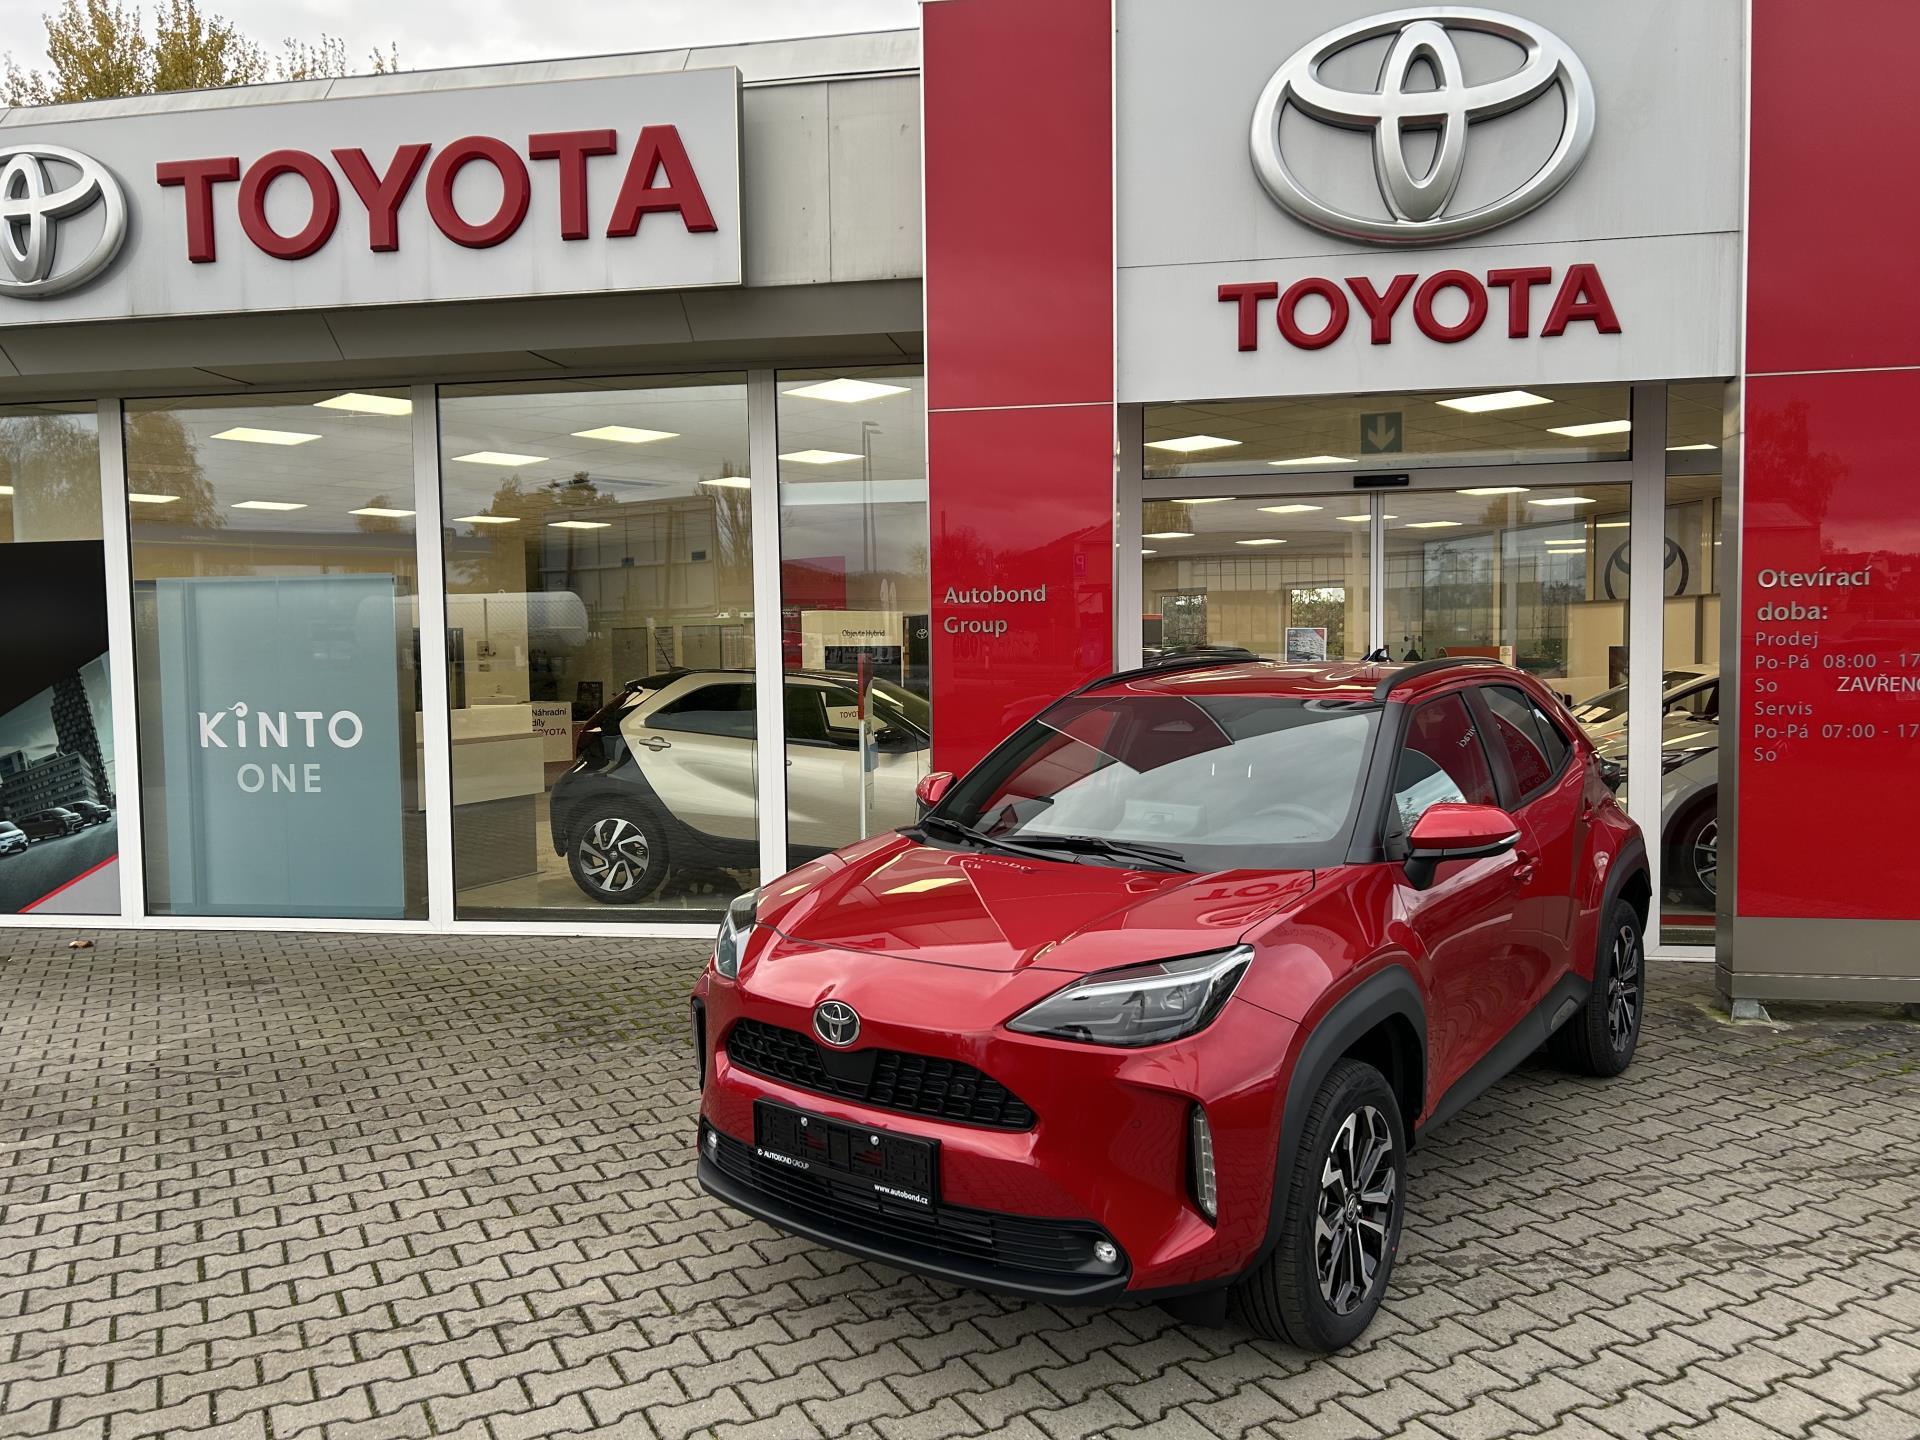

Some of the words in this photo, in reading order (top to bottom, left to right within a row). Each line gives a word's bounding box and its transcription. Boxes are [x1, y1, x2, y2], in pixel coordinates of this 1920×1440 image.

[157, 125, 718, 263] TOYOTA
[1218, 264, 1621, 352] TOYOTA
[1757, 566, 1872, 588] Otevírací
[943, 583, 1047, 604] Autobond
[1757, 601, 1829, 621] doba:
[943, 616, 1008, 638] Group
[1755, 631, 1819, 649] Prodej
[1755, 654, 1810, 669] Po-Pá
[1823, 654, 1877, 669] 08:00
[1754, 678, 1778, 693] So
[1754, 701, 1813, 716] Servis
[533, 727, 567, 737] YOTA
[1754, 723, 1809, 739] Po-Pá
[1822, 724, 1876, 739] 07:00
[1754, 747, 1777, 761] So
[236, 763, 322, 793] ONE
[763, 1150, 793, 1166] AUTOBOND
[873, 1183, 929, 1206] www.autobond.cz
